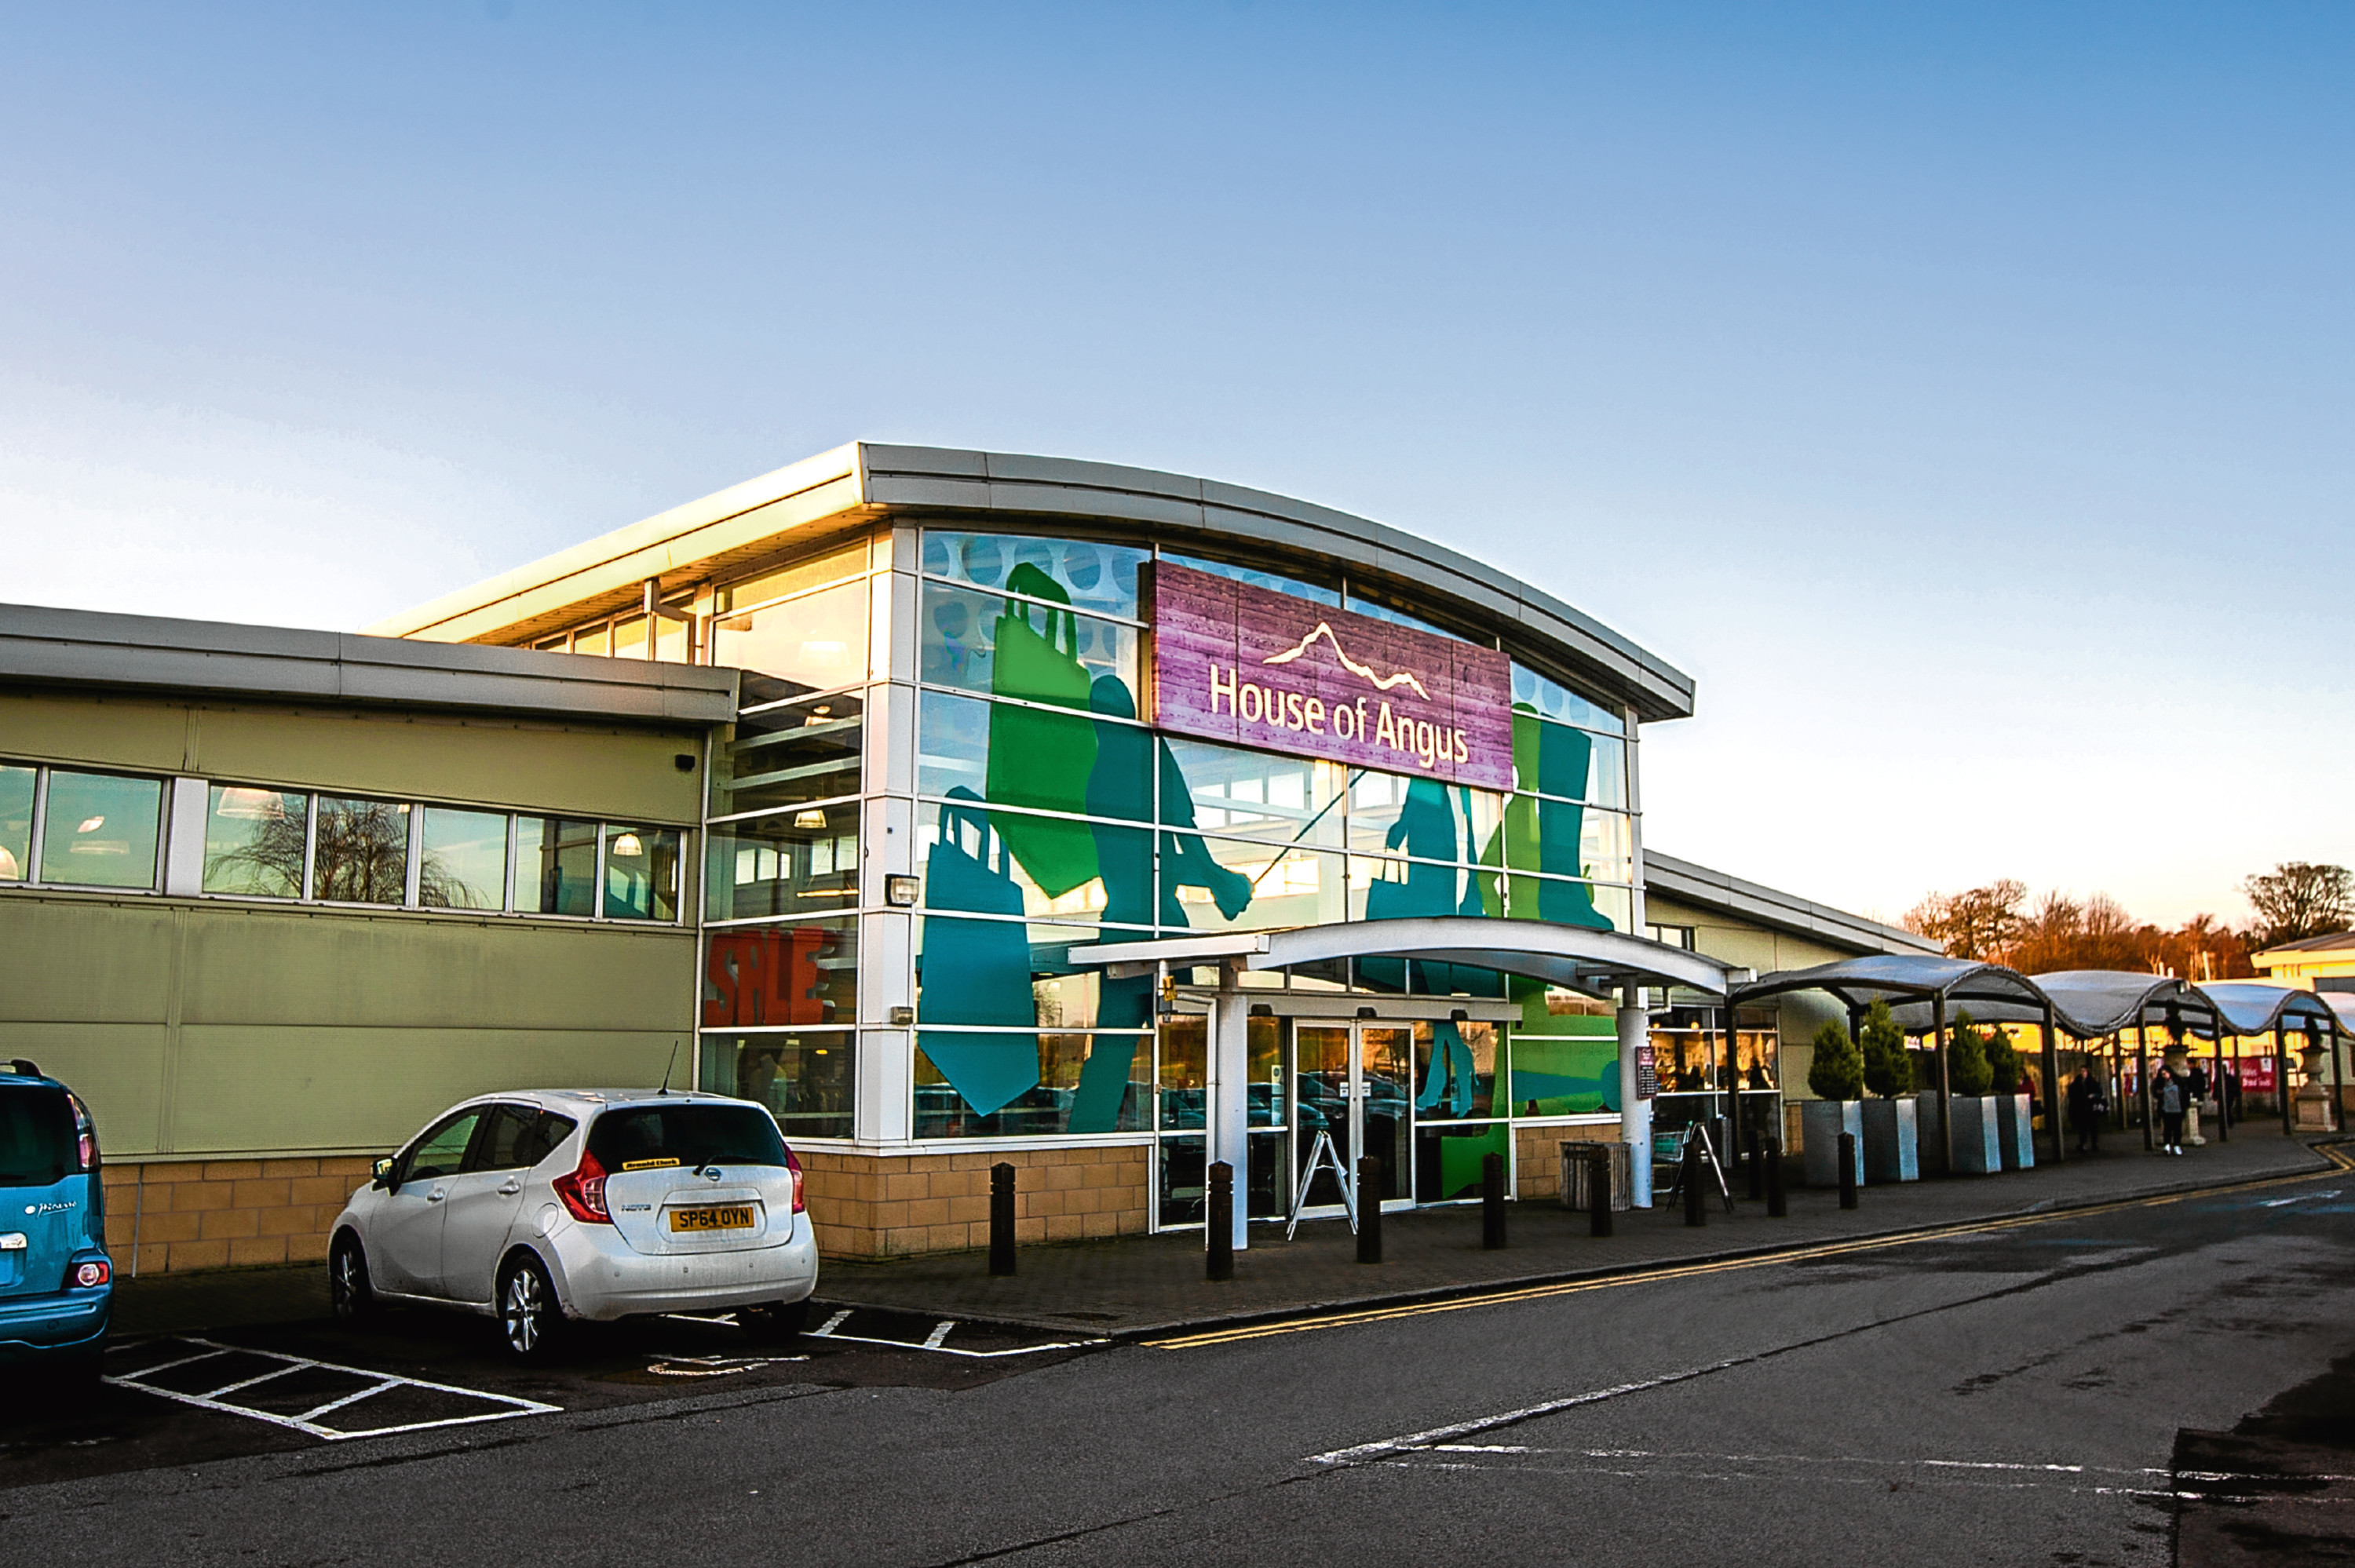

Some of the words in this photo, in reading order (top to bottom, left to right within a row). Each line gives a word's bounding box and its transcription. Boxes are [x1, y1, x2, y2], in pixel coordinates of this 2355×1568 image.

[1210, 664, 1325, 735] House
[1334, 696, 1367, 742] of
[1375, 702, 1469, 768] Angus
[704, 924, 824, 1026] SALE
[679, 1211, 718, 1228] SP64
[721, 1209, 750, 1225] OYN
